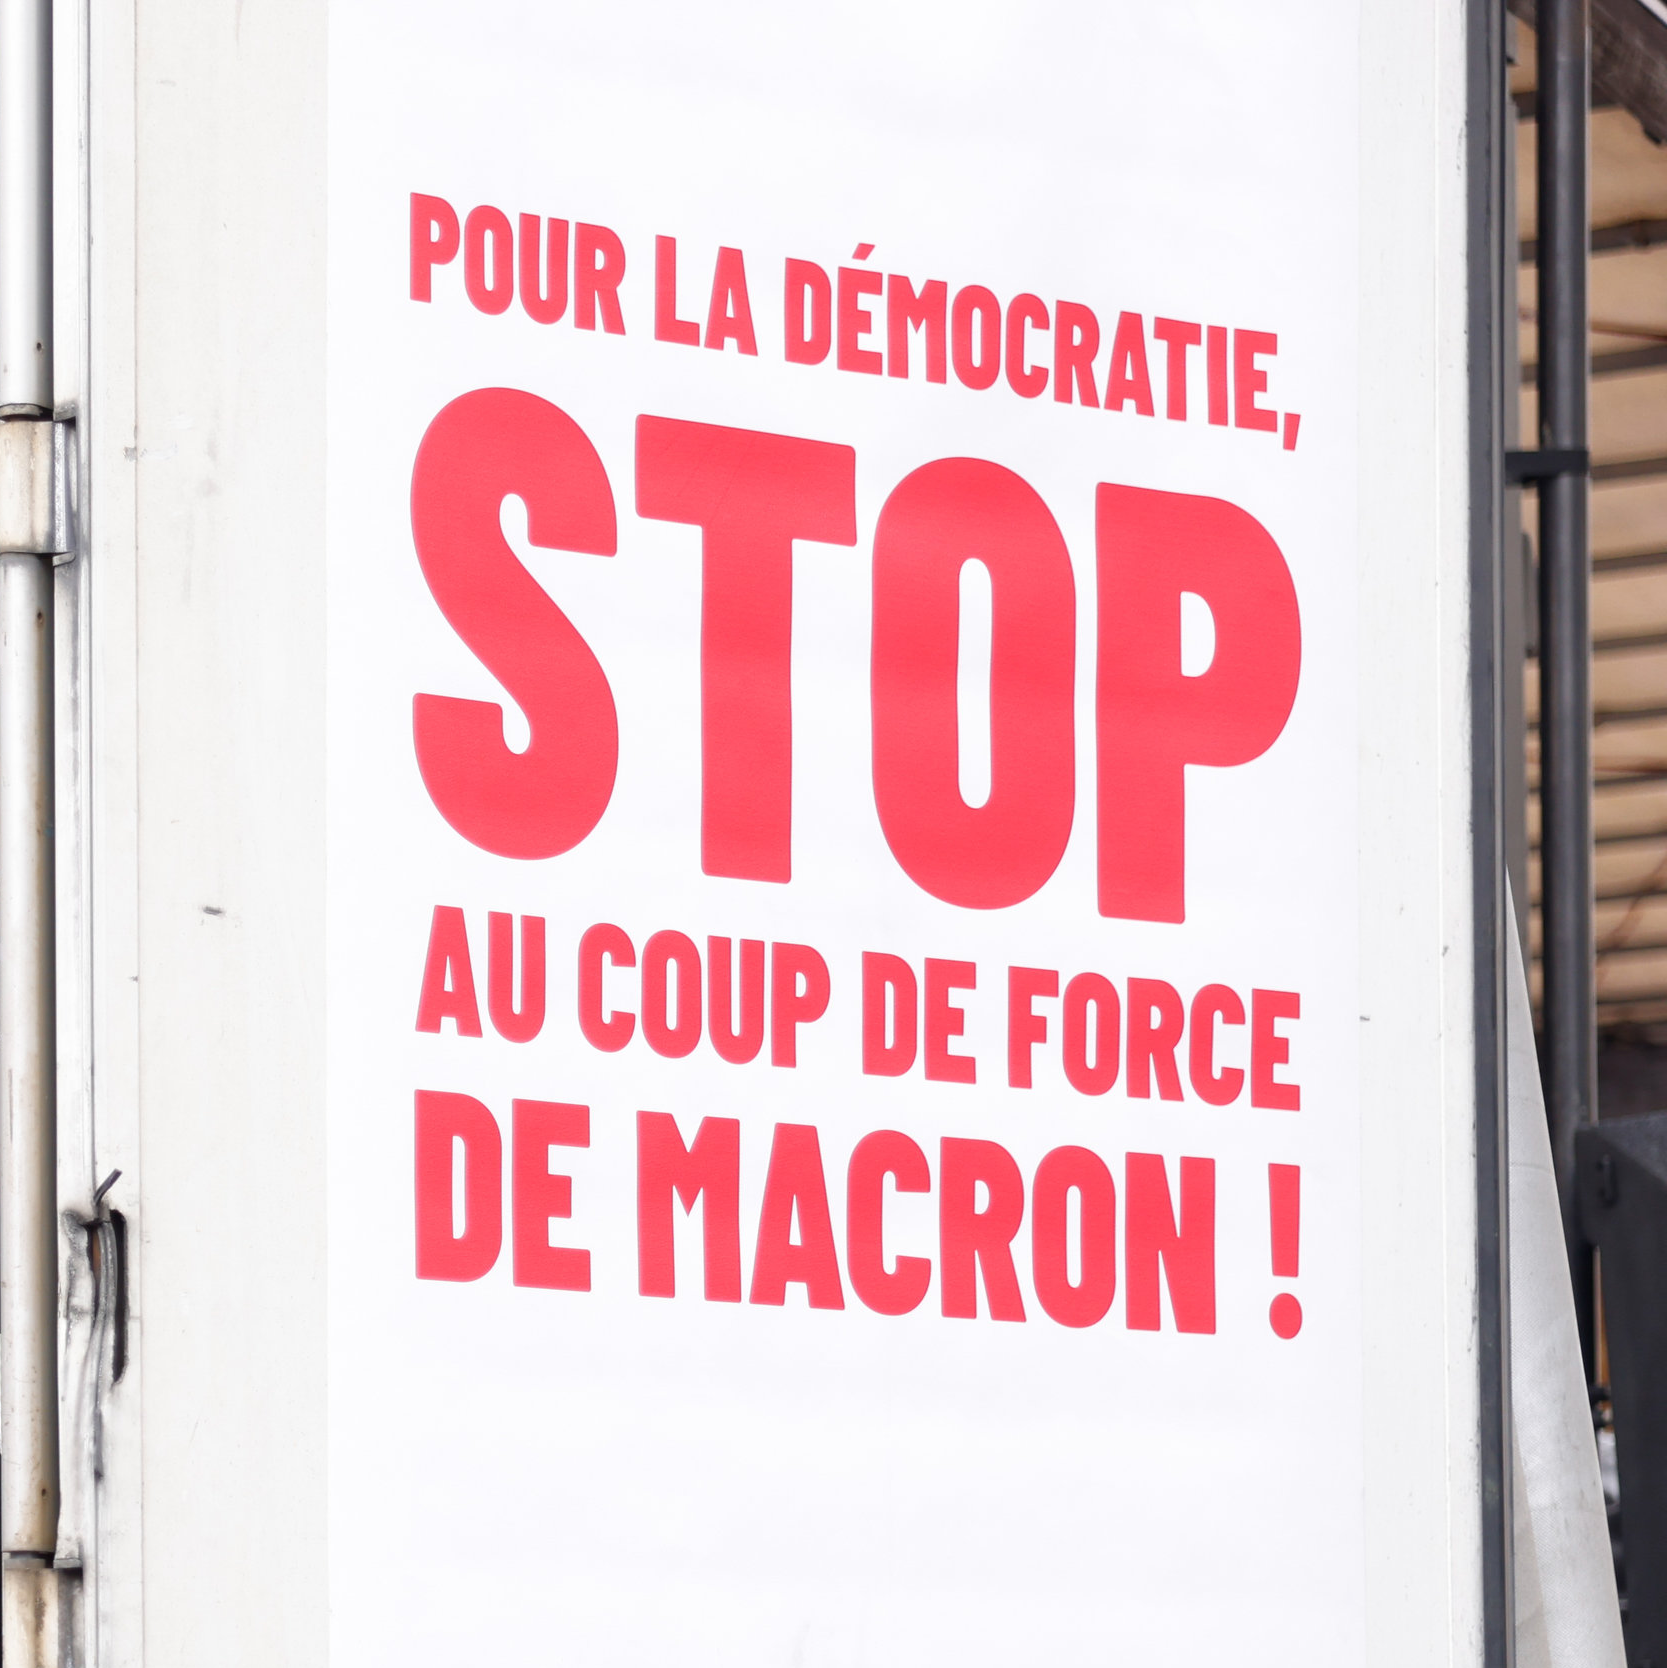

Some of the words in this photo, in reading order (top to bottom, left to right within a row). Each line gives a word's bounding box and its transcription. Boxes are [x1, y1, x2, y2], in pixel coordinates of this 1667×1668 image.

[411, 193, 625, 335] POUR
[655, 235, 758, 356] LA
[785, 243, 1300, 451] DÉMOCRATIE,
[411, 387, 1301, 924] STOP
[416, 905, 545, 1043] AU
[579, 923, 830, 1068] COUP
[863, 951, 976, 1084] DE
[1009, 966, 1300, 1111] FORCE
[415, 1090, 591, 1292] DE
[637, 1111, 1216, 1335] MACRON
[1269, 1163, 1302, 1340] !
